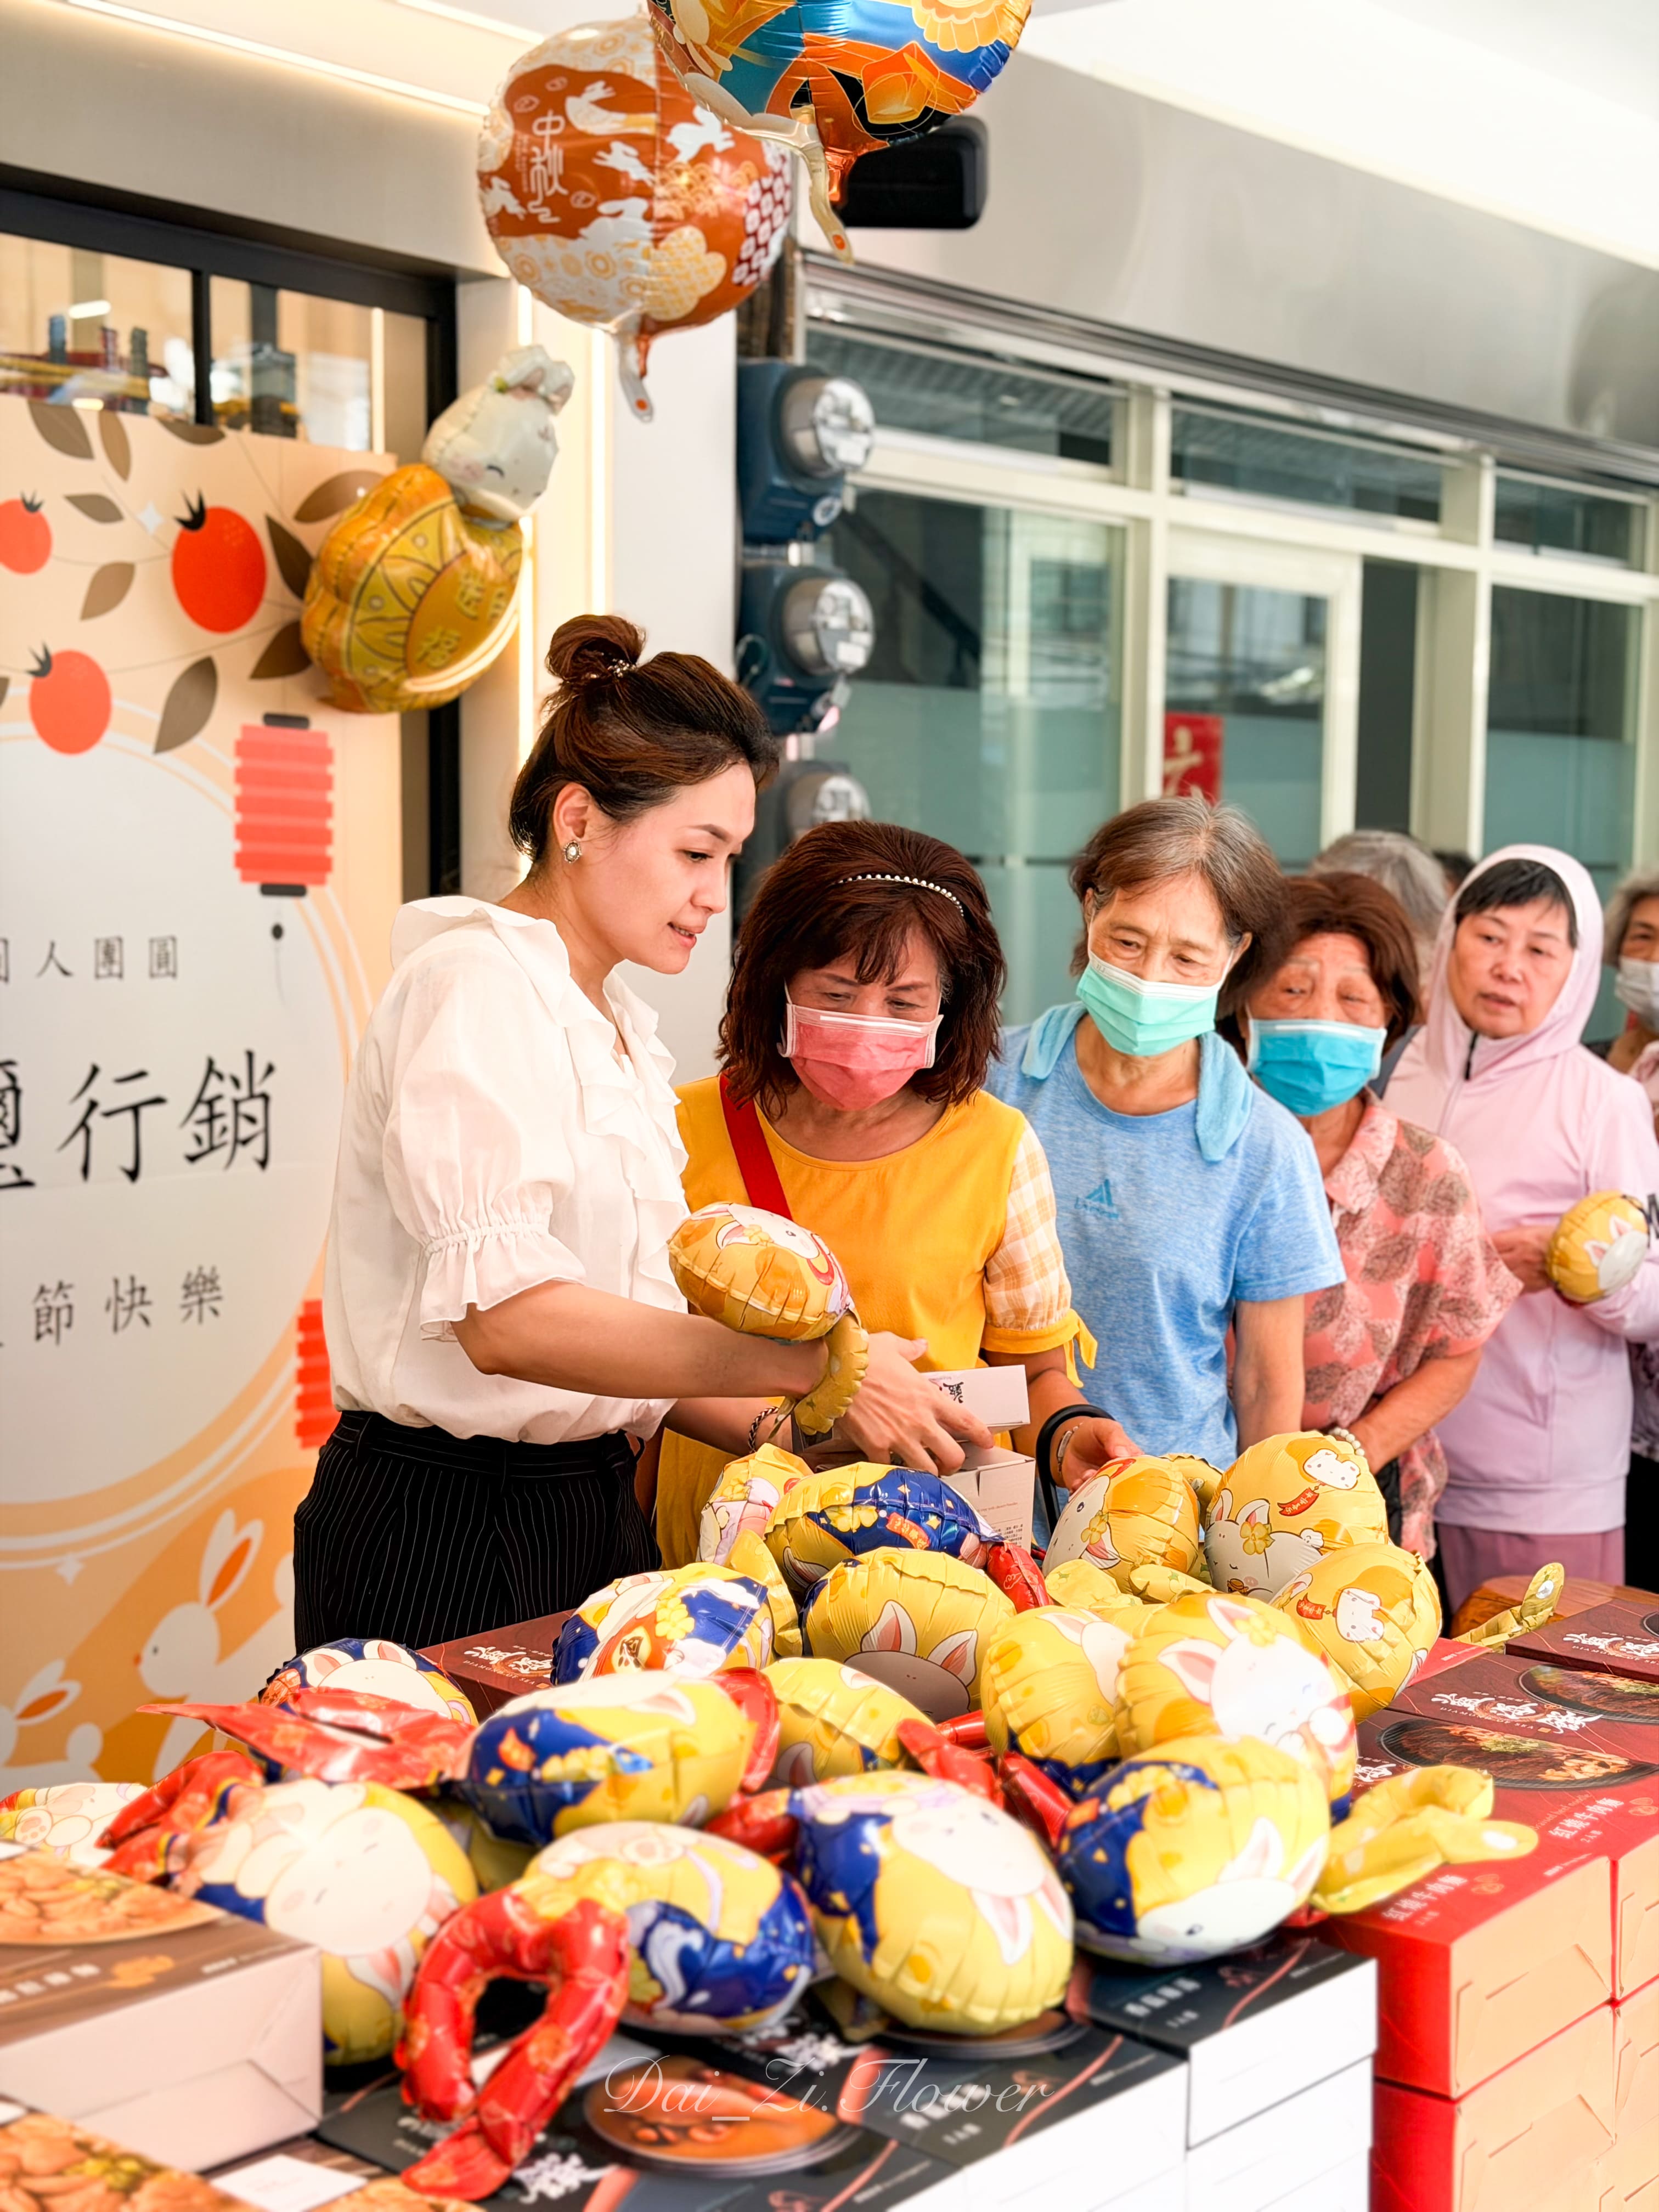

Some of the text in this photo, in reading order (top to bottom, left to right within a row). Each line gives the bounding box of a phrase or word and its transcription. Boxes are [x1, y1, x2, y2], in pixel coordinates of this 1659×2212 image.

[0, 935, 177, 983] 人團圓
[0, 1265, 224, 1348] 節快樂
